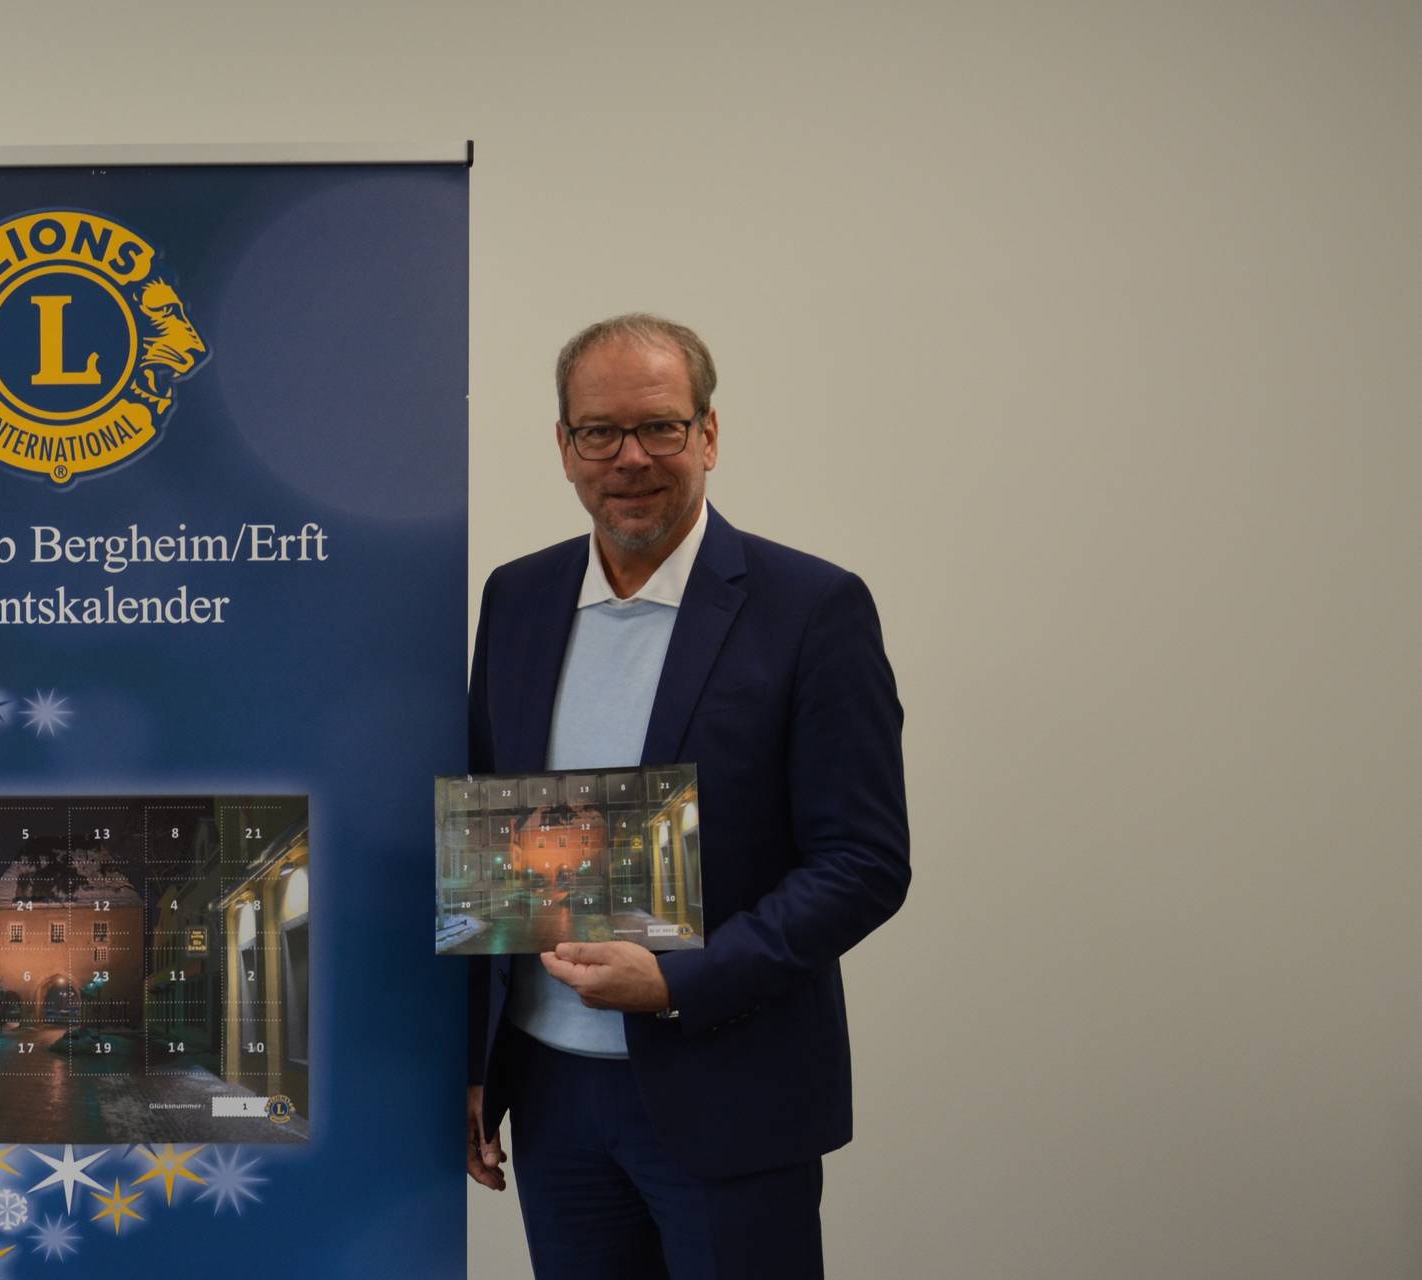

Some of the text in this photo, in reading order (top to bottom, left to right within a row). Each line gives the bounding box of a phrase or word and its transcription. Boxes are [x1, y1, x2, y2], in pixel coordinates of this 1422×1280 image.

[30, 295, 102, 386] L
[30, 523, 328, 573] Bergheim/Erft
[22, 829, 29, 839] 5
[94, 829, 110, 839] 13
[171, 828, 179, 838] 8
[246, 829, 262, 839] 21
[17, 901, 33, 911] 24
[94, 901, 110, 911] 12
[170, 901, 178, 911] 4
[248, 900, 261, 910] 8
[23, 972, 31, 982] 6
[93, 971, 110, 982] 23
[170, 971, 186, 981] 11
[247, 971, 255, 981] 2
[18, 1043, 34, 1053] 17
[95, 1043, 111, 1053] 19
[168, 1042, 184, 1053] 14
[248, 1043, 264, 1053] 10
